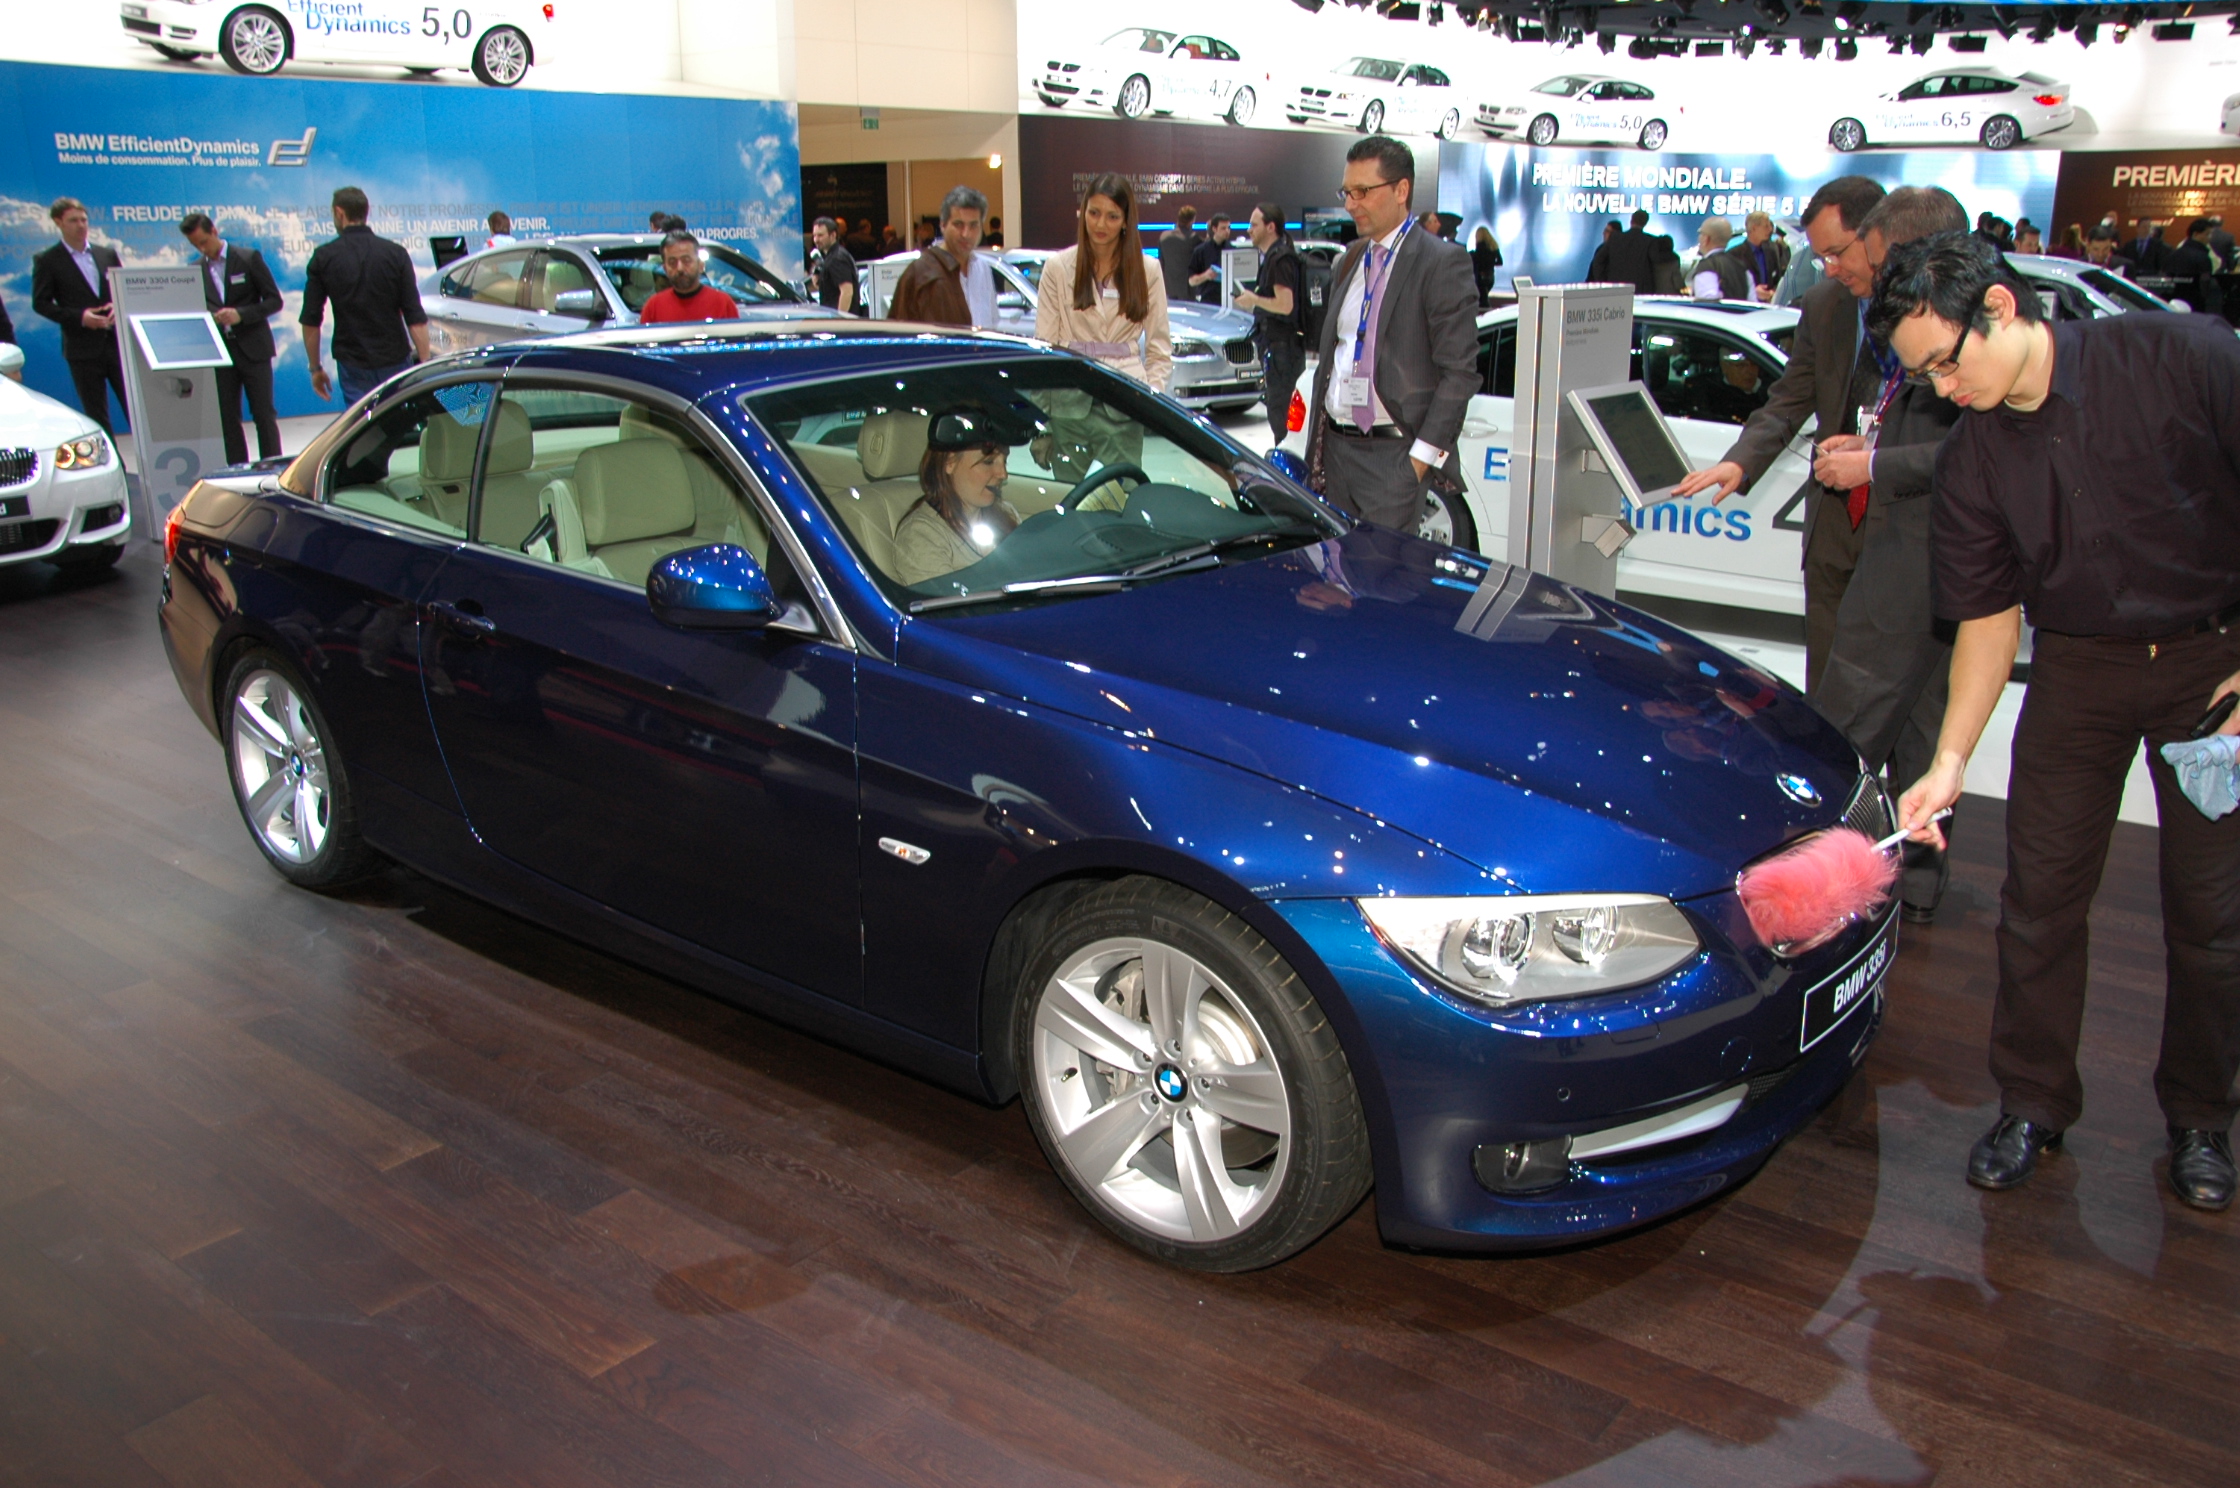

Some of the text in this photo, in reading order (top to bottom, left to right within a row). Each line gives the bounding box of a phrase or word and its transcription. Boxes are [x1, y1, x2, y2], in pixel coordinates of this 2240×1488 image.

[306, 7, 472, 45] Dynamics 5,0
[1619, 114, 1643, 131] 5,0
[1941, 111, 1971, 129] 6,5
[54, 133, 260, 155] BMW EfficientDynamics
[58, 152, 93, 165] Moins
[95, 154, 109, 165] de
[111, 155, 191, 167] consommation.
[192, 156, 214, 167] Plus
[216, 157, 229, 167] de
[1532, 161, 1753, 190] PREMIÈRE MONDIALE.
[1542, 192, 1563, 213] LA
[1564, 192, 1654, 215] NOUVELLE
[1657, 193, 1711, 215] BMW
[1711, 191, 1776, 216] SÉRIE
[112, 206, 183, 222] FREUDE
[378, 204, 427, 217] NOTRE
[407, 218, 429, 233] UN
[430, 218, 479, 233] AVENIR
[1566, 309, 1587, 324] BMW
[1603, 306, 1626, 321] Cabrio
[1833, 961, 1868, 1014] BMW
